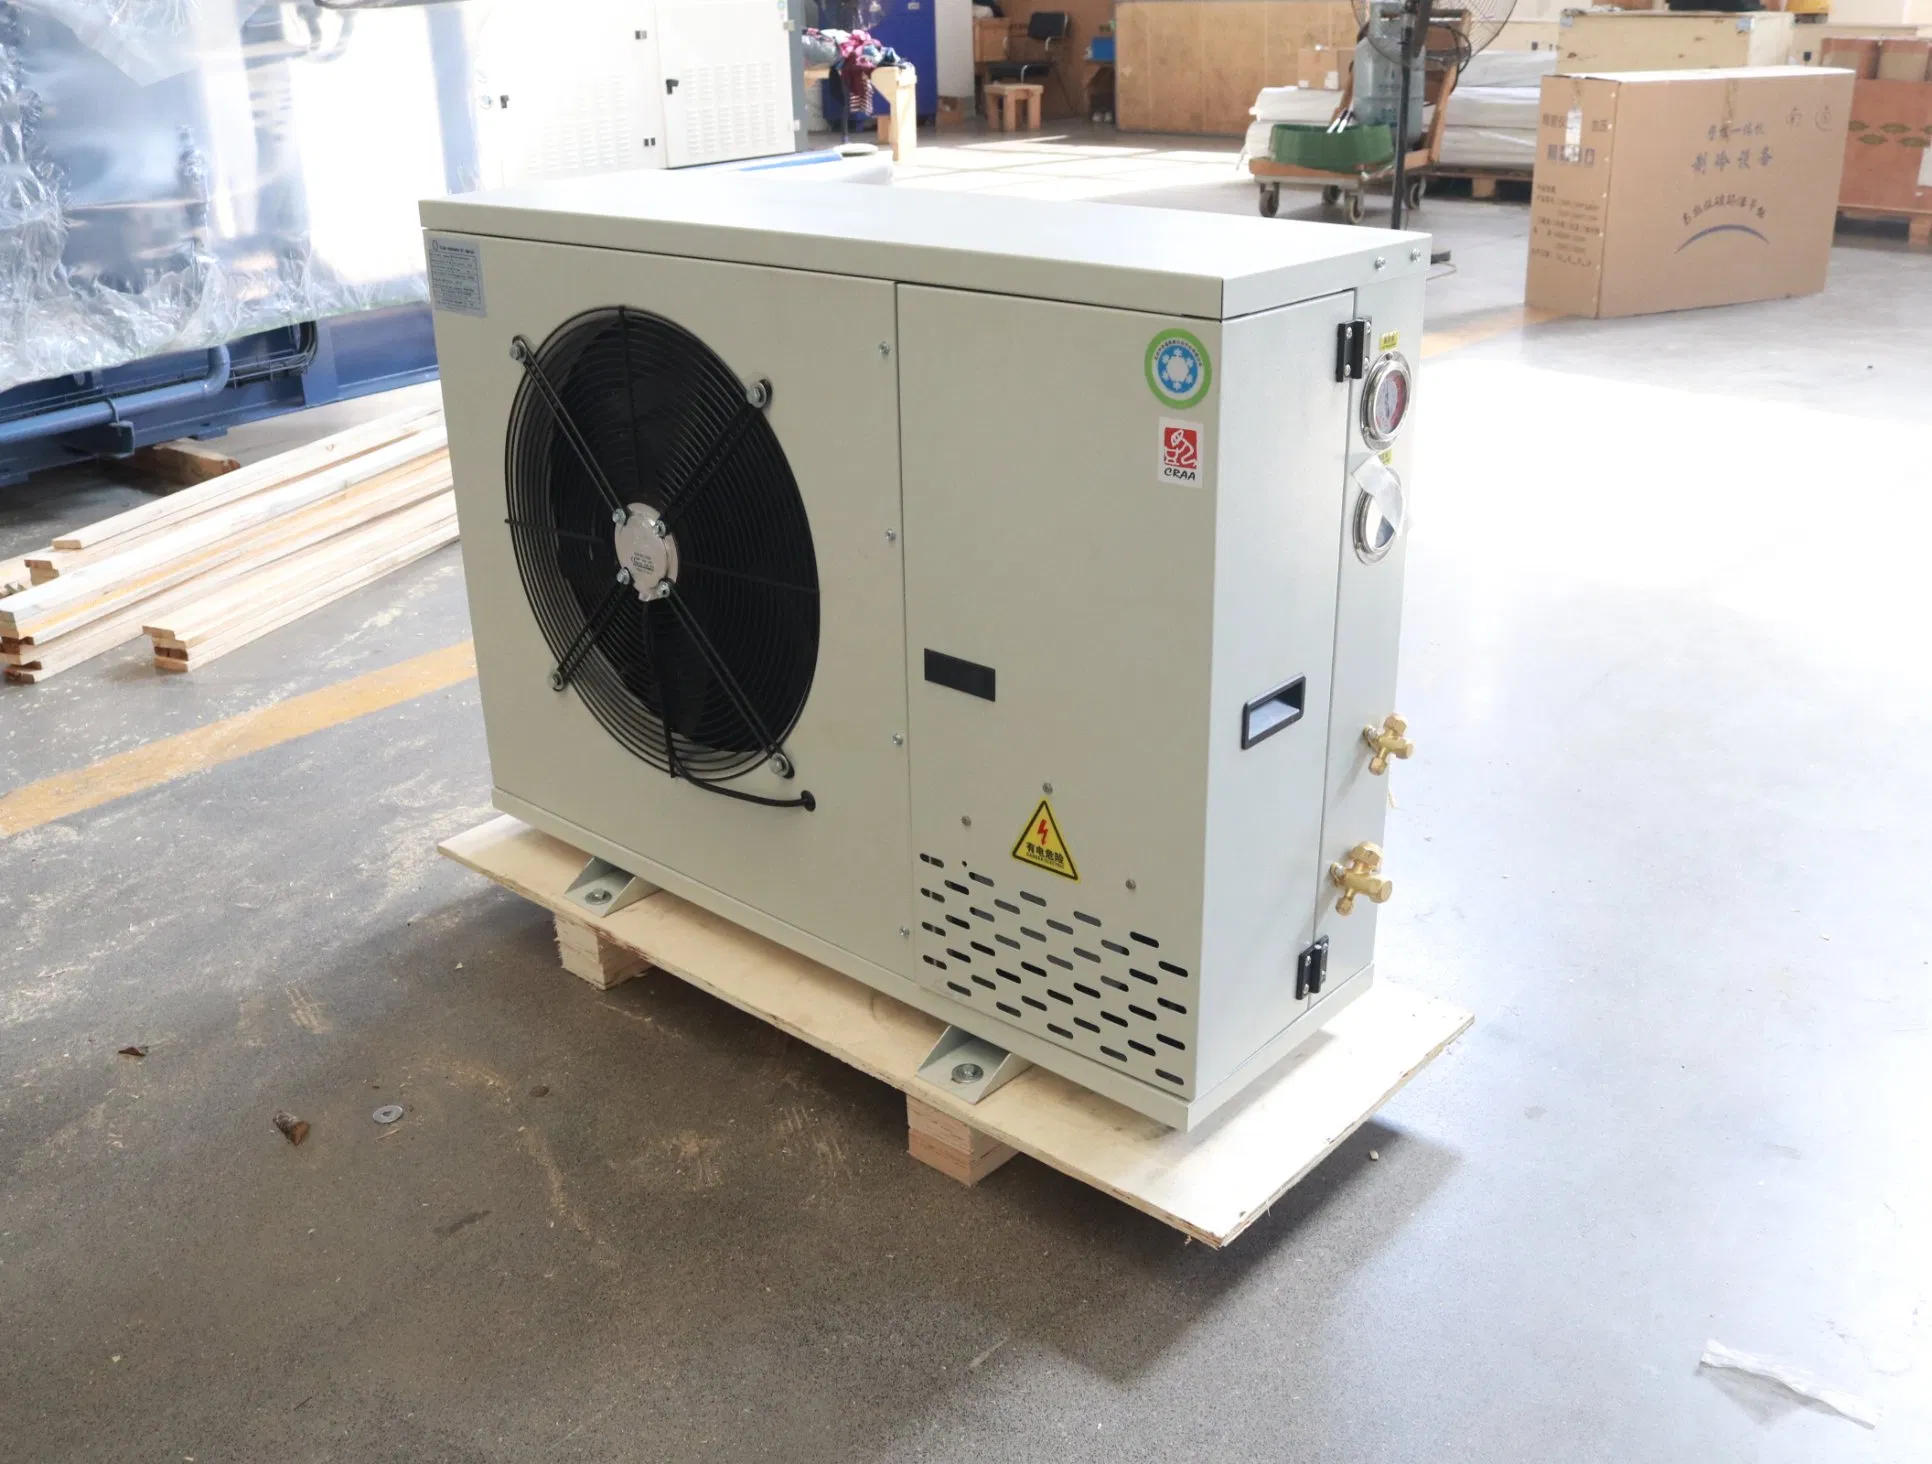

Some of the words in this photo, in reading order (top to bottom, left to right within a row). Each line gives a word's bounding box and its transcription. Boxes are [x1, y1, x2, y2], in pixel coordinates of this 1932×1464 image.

[1164, 467, 1196, 481] CRAA
[1026, 842, 1064, 864] 有电危险
